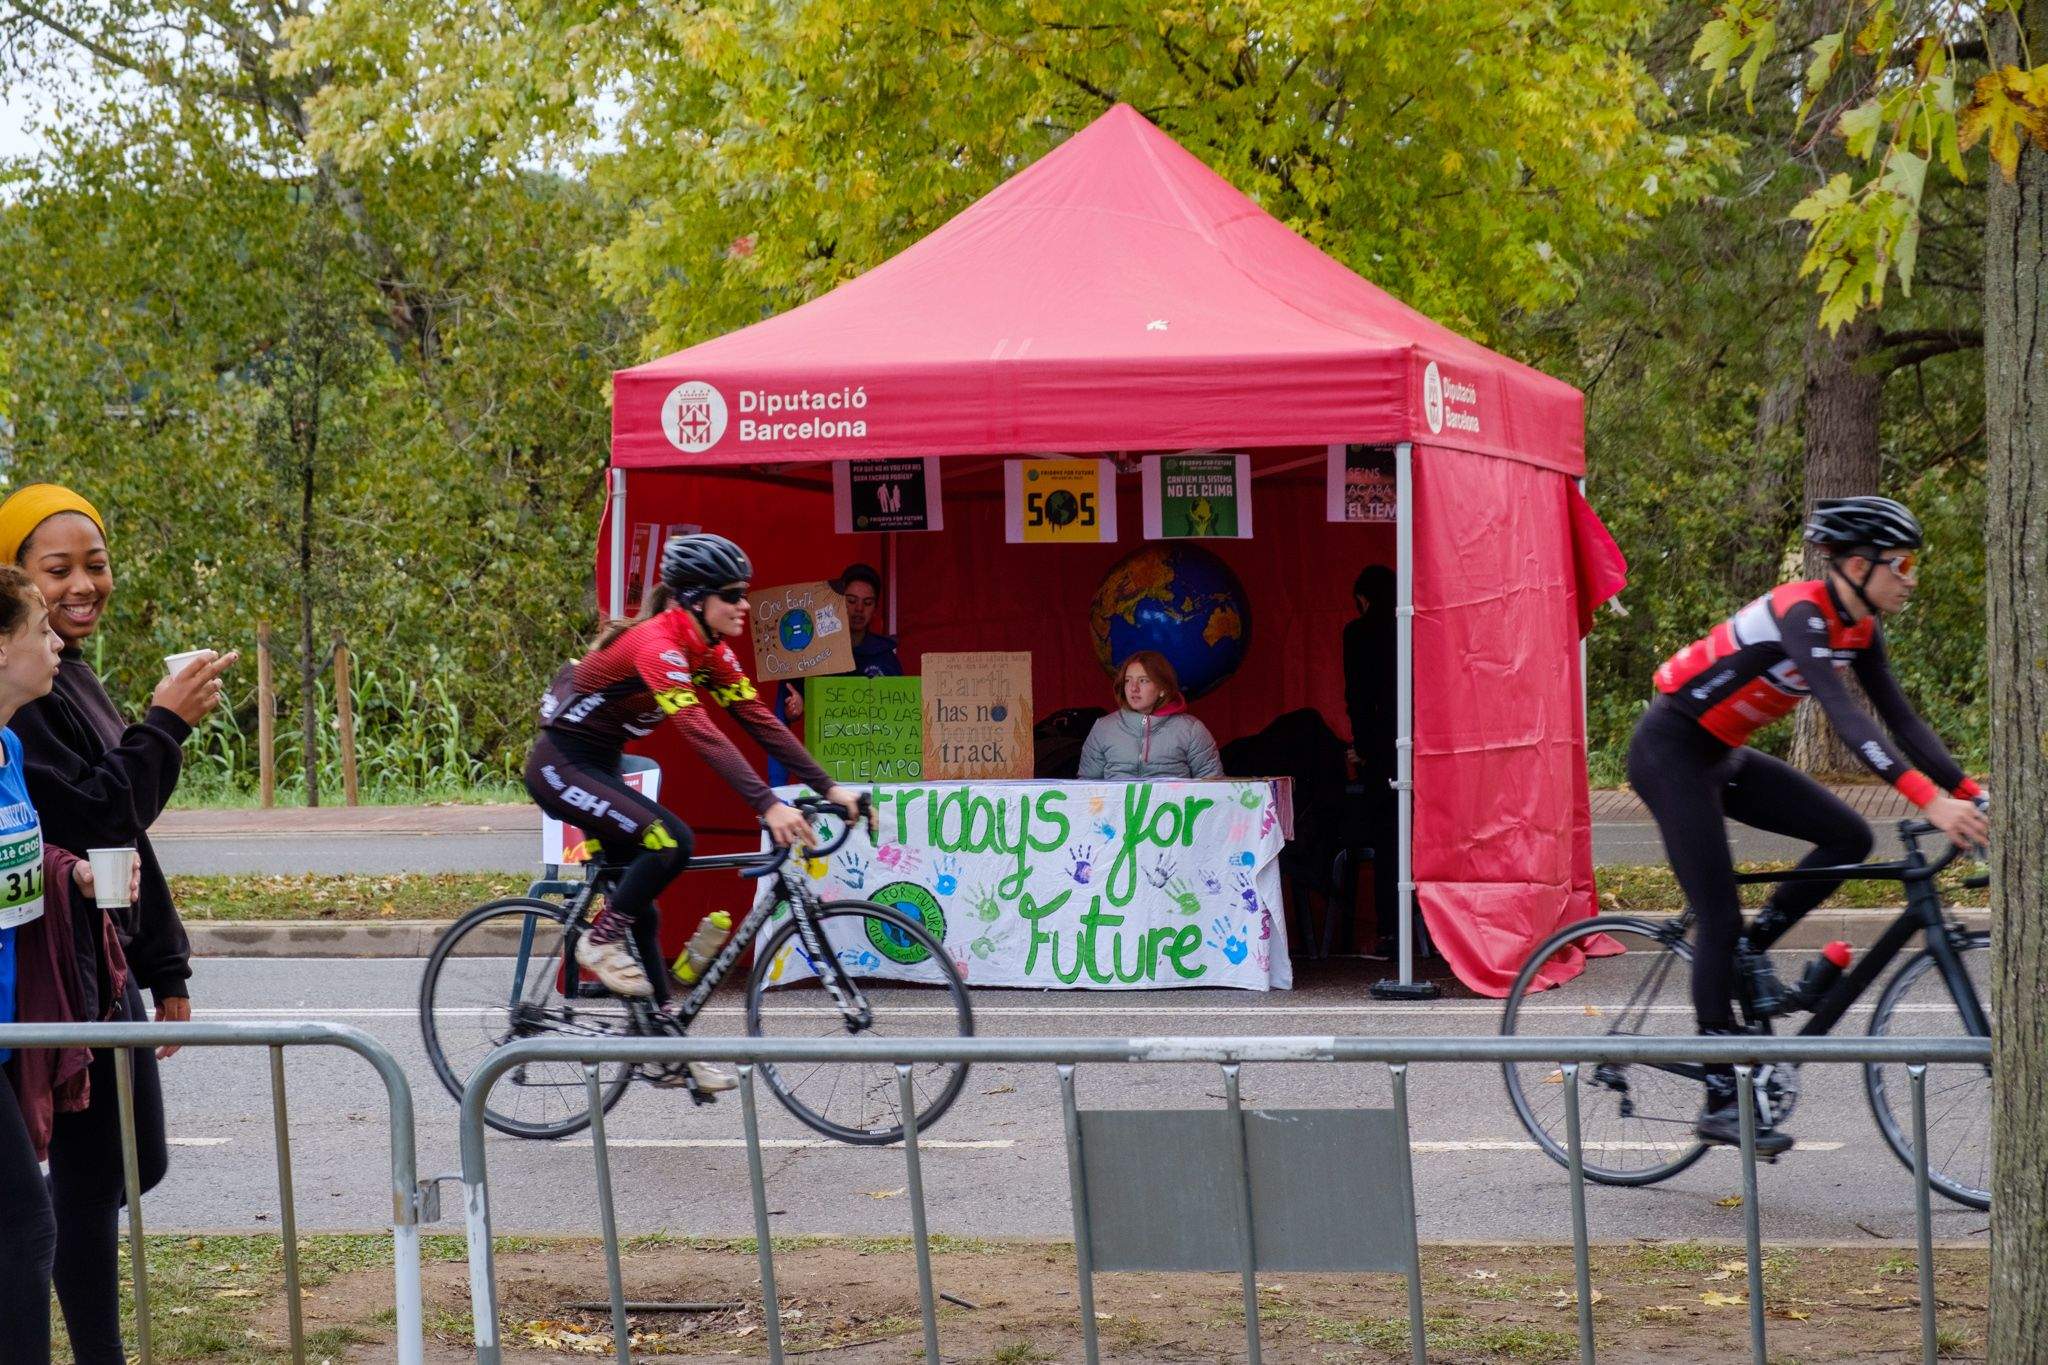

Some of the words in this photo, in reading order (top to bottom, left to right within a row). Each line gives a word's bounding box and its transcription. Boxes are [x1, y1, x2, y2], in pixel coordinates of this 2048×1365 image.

[739, 386, 868, 416] Diputació
[739, 417, 867, 441] Barcelona
[1167, 485, 1183, 498] NO
[1186, 485, 1200, 497] EL
[1201, 484, 1233, 497] CLIMA
[1348, 503, 1364, 517] EL
[1367, 503, 1398, 517] TEM
[786, 590, 814, 610] Earth
[934, 670, 1012, 698] Earth
[825, 687, 847, 703] SE
[851, 688, 876, 704] OS
[879, 688, 916, 704] HAN
[824, 705, 888, 720] ACABADO
[894, 707, 923, 721] LAS
[935, 698, 969, 722] has
[823, 723, 893, 738] EXCUSAS
[909, 725, 919, 738] A
[823, 741, 896, 757] NOSOTRAS
[904, 743, 923, 755] EL
[942, 742, 1006, 763] track
[560, 785, 612, 818] BH
[881, 886, 908, 902] FOR
[1018, 888, 1208, 985] Future
